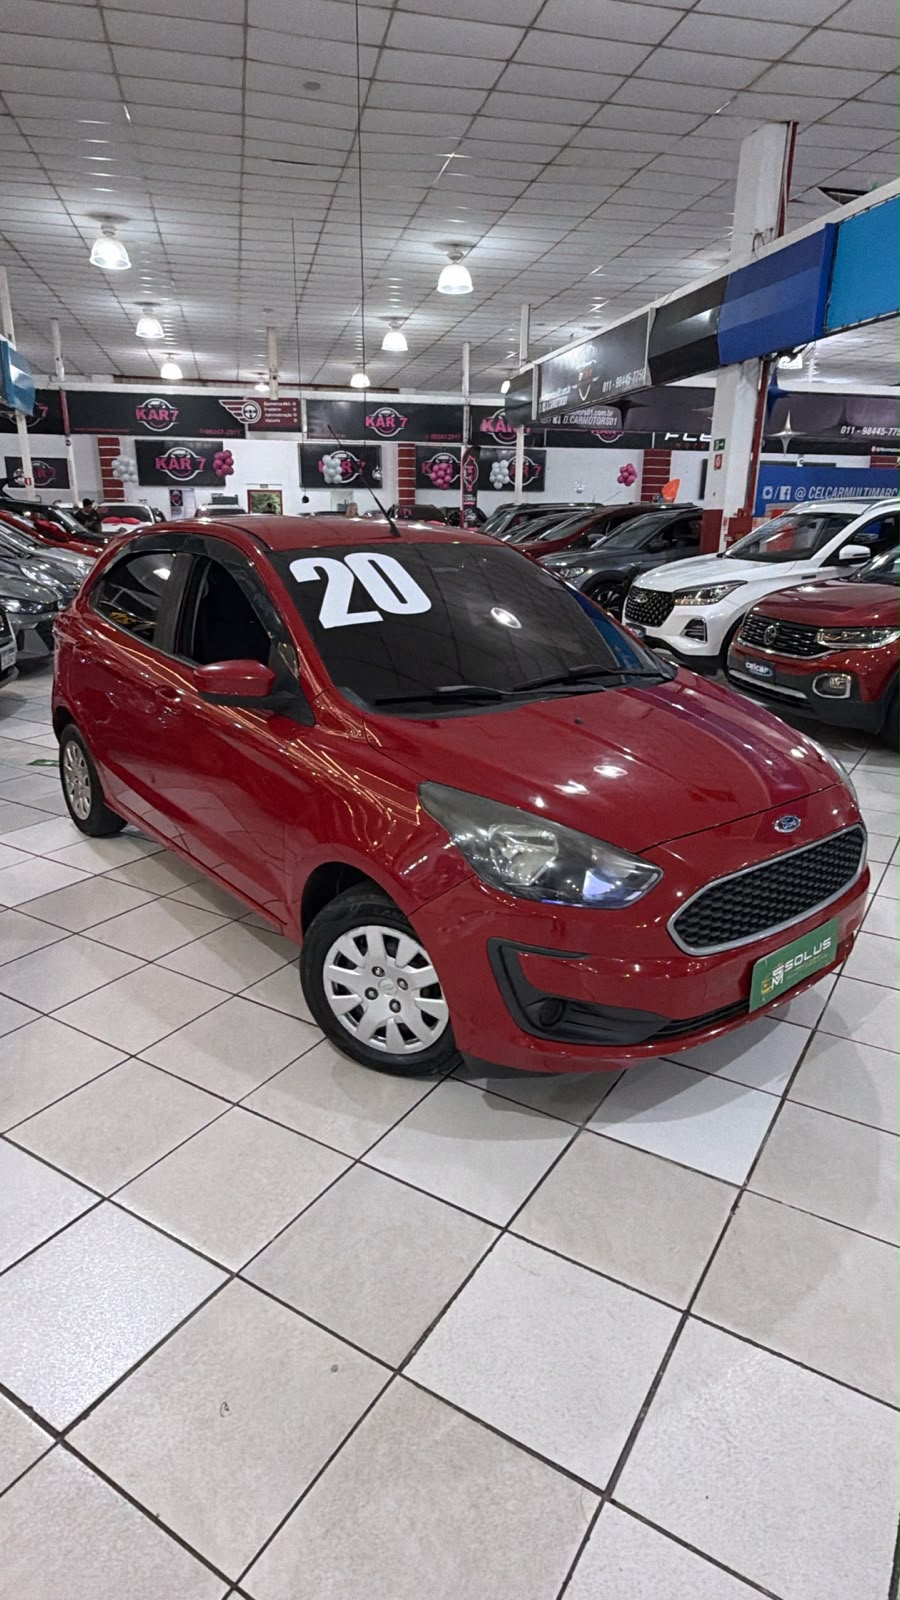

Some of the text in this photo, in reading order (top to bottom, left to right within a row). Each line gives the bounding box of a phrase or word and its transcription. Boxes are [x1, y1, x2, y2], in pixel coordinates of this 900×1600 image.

[365, 416, 408, 428] KAR 7
[840, 425, 856, 435] 011
[155, 457, 207, 471] KAR 7
[289, 552, 432, 629] 20
[784, 936, 832, 972] SOLUS
